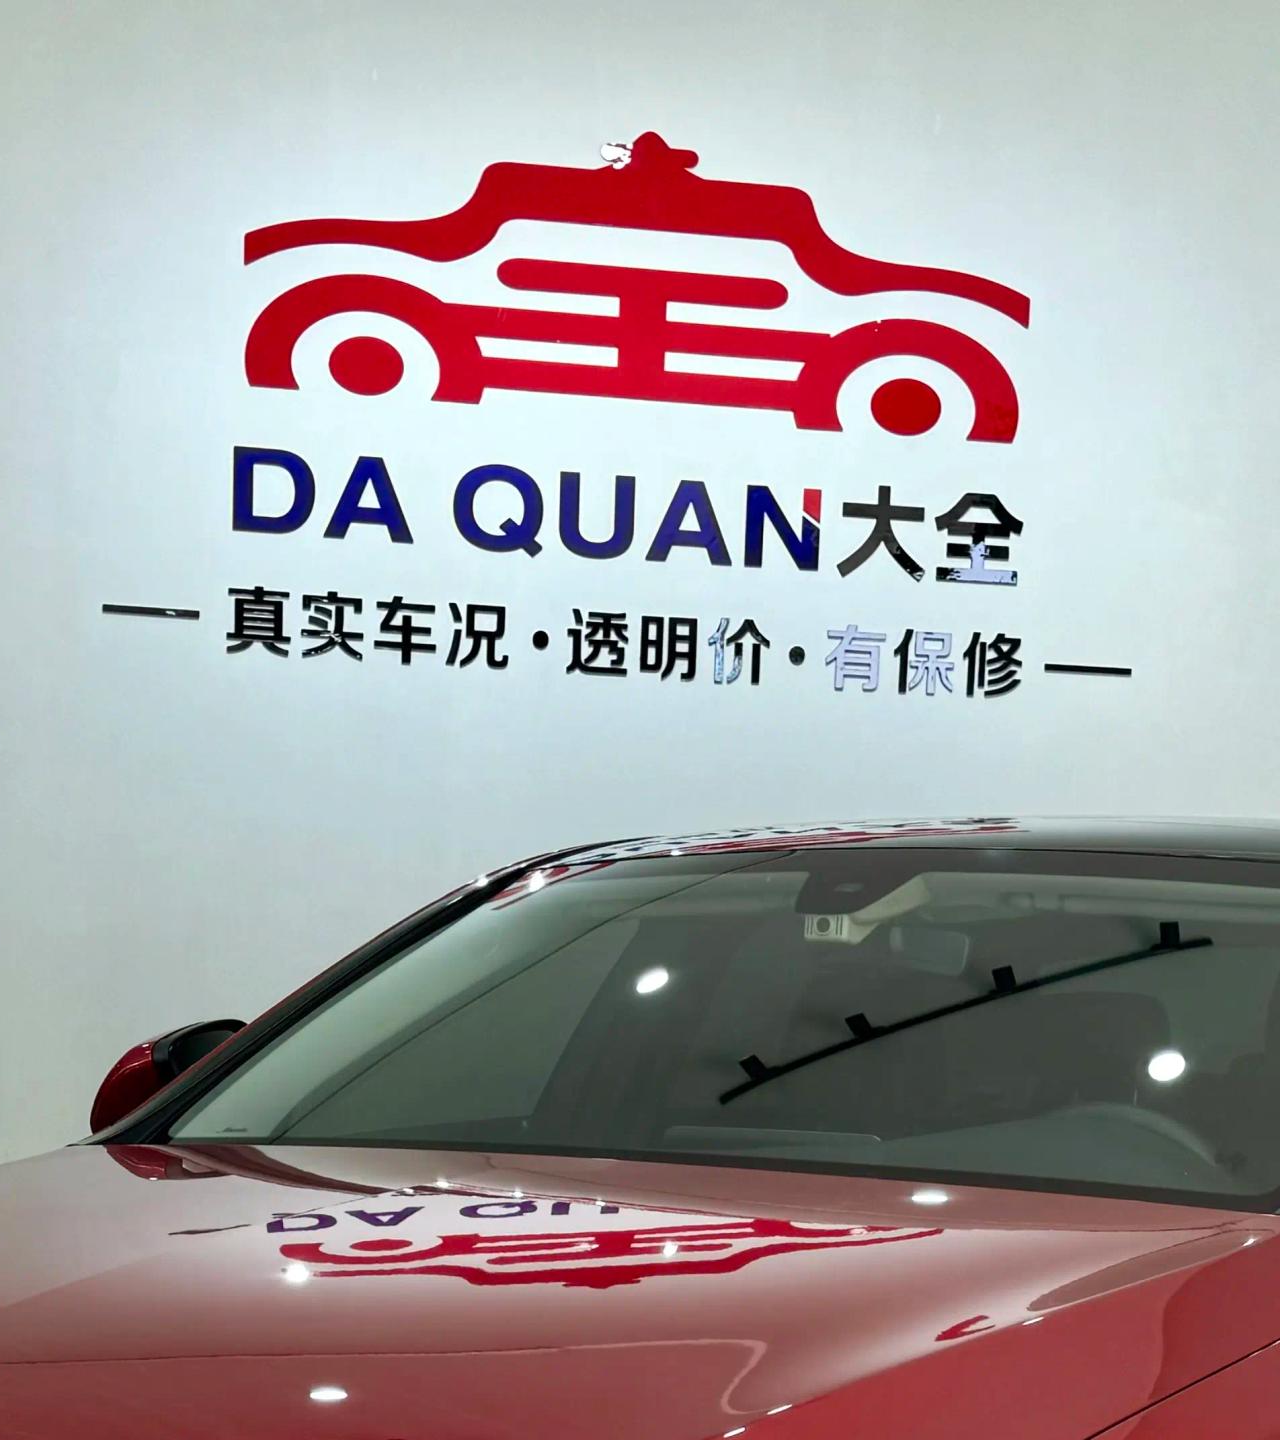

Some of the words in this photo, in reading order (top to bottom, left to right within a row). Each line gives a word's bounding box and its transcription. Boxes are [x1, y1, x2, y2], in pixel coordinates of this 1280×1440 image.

[232, 445, 414, 545] DA
[452, 464, 822, 572] QUAN
[837, 485, 1024, 587] 大全
